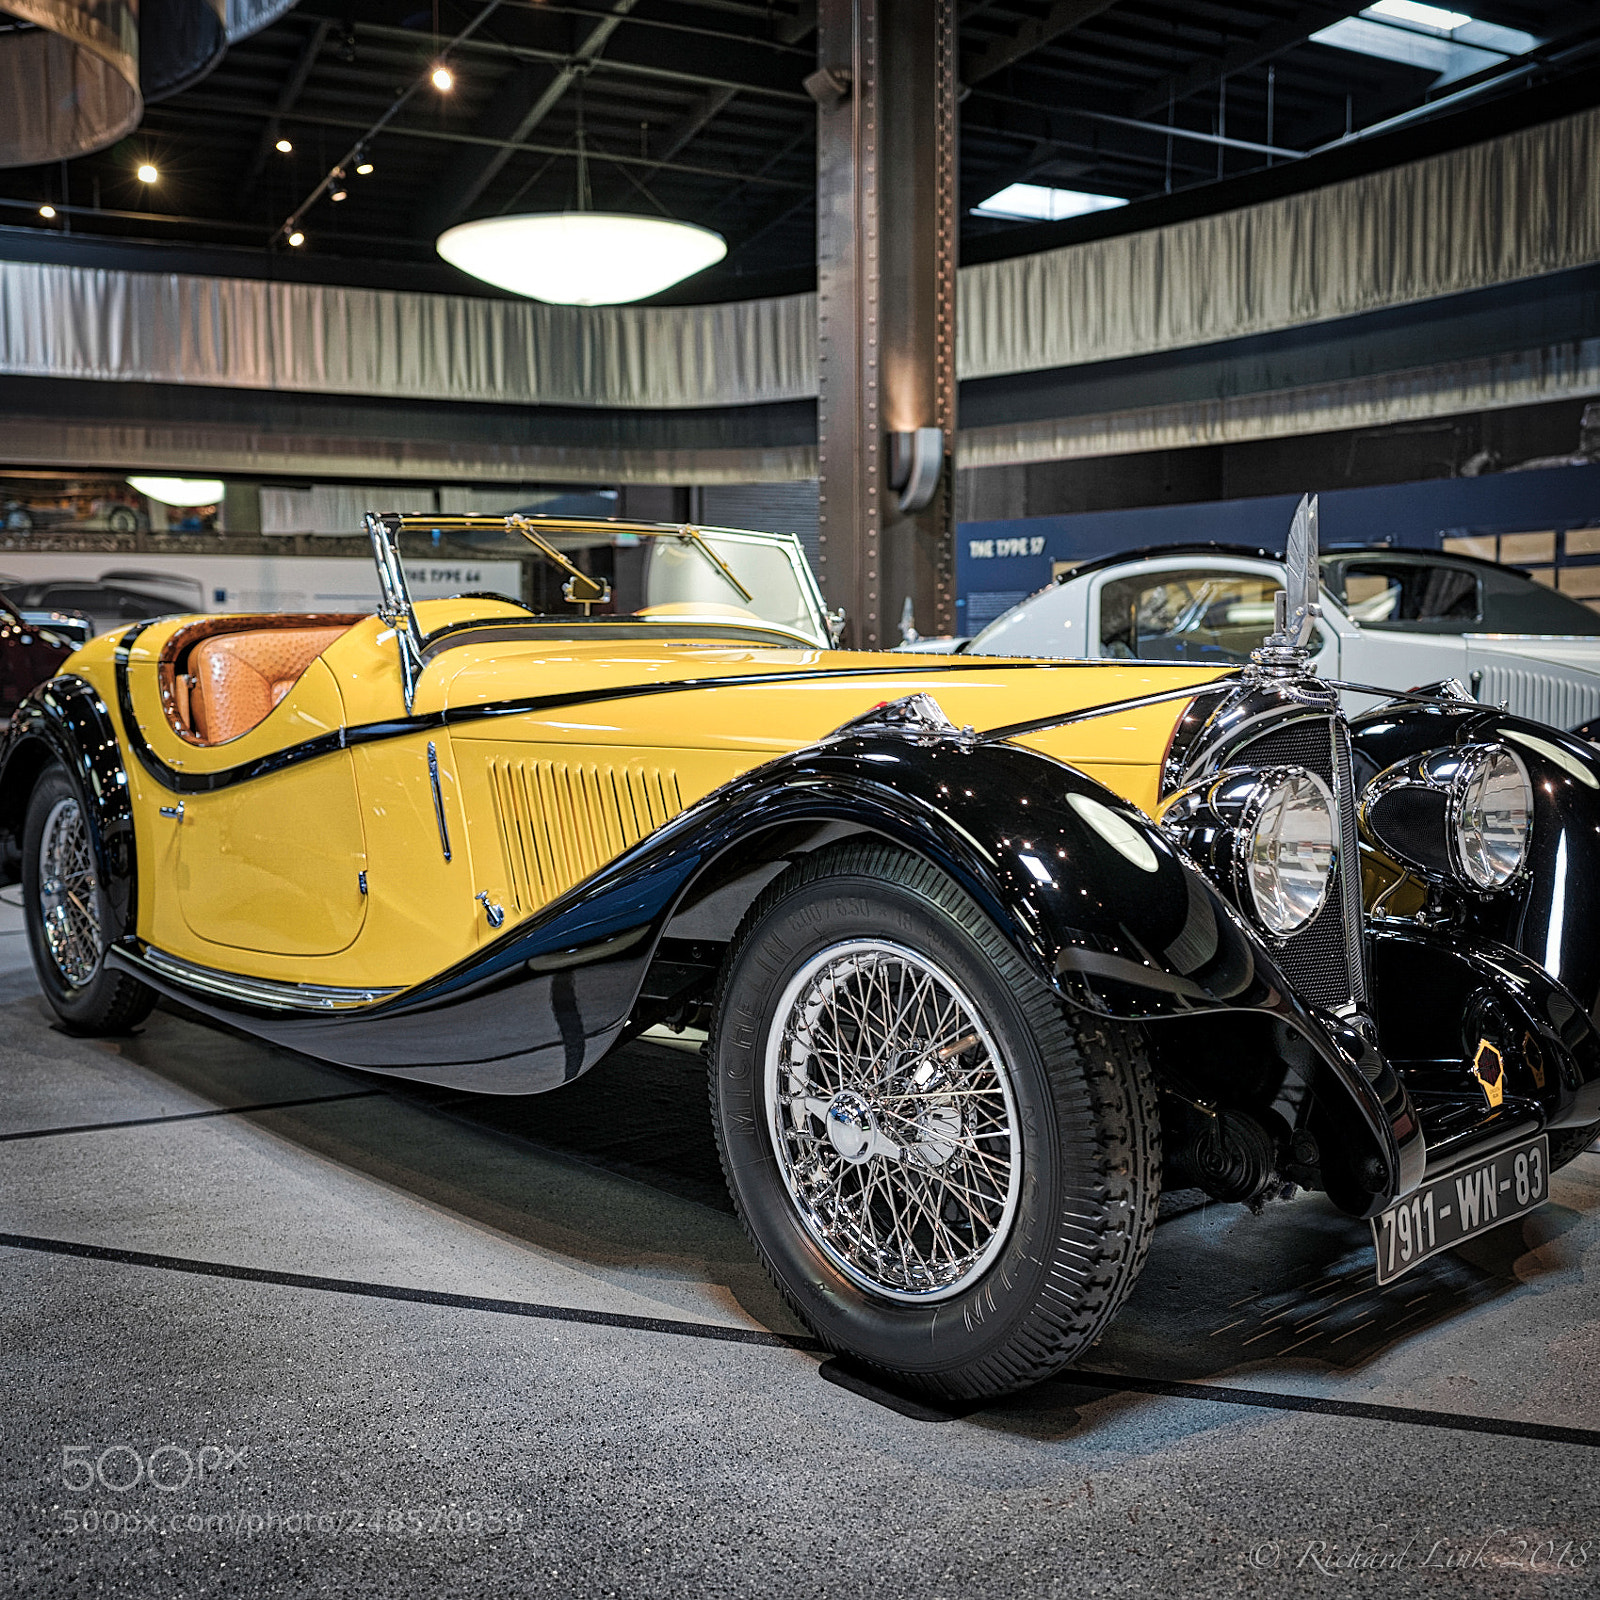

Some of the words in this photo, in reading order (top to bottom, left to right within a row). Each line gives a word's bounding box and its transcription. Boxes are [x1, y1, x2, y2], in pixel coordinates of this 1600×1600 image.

[996, 537, 1028, 556] TYPE
[430, 569, 461, 581] TYPE
[726, 930, 791, 1135] MICHELIN
